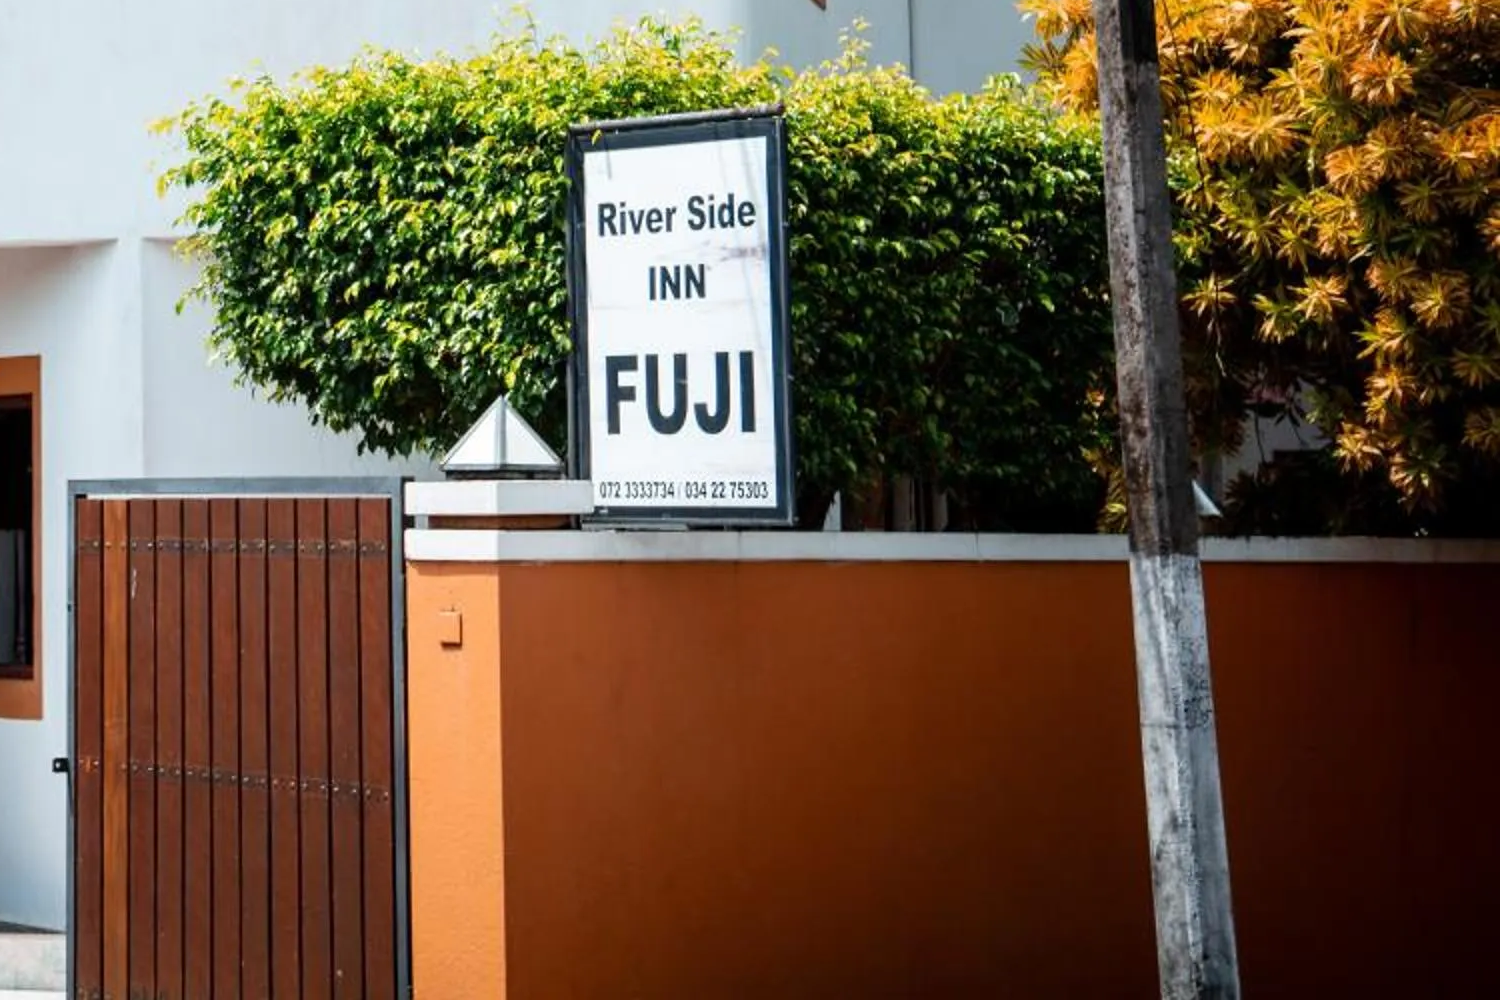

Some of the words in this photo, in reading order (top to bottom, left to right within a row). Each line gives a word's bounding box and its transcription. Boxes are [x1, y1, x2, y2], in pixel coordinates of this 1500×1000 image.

[598, 201, 677, 237] River
[687, 193, 757, 231] Side
[648, 263, 706, 301] INN
[605, 350, 757, 436] FUJI
[599, 481, 621, 499] 072
[624, 481, 675, 499] 3333734
[684, 481, 707, 499] 034
[711, 481, 726, 499] 22
[730, 480, 769, 499] 75303
